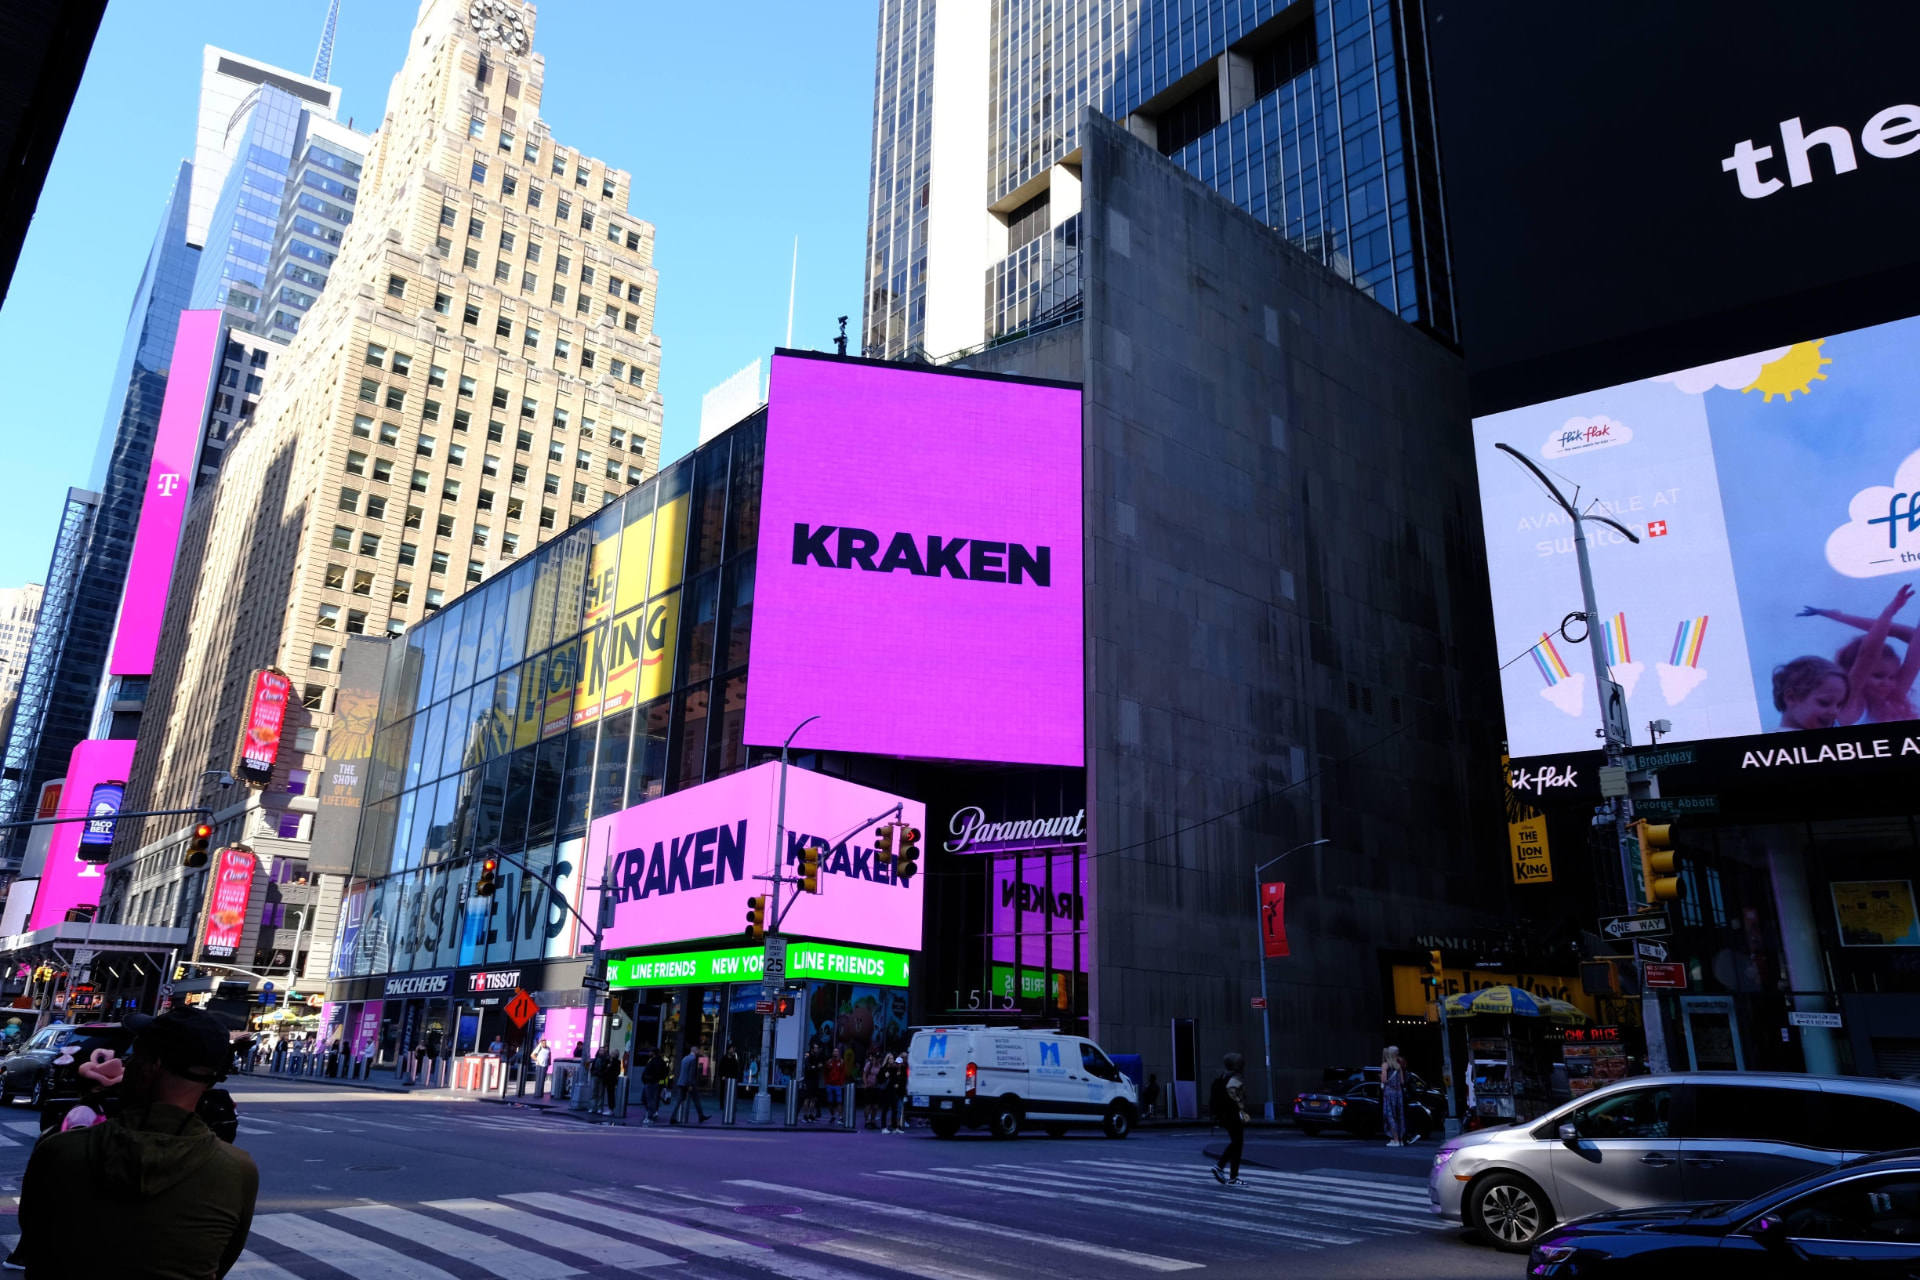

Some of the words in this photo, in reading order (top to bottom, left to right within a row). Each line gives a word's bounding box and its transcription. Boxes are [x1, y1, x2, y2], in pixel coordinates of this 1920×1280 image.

[1721, 103, 1920, 200] the
[1517, 495, 1644, 533] AVAIABLE
[1652, 488, 1681, 508] AT
[792, 522, 1051, 587] KRAKEN
[588, 605, 668, 697] KING
[575, 711, 583, 721] ON
[604, 695, 624, 710] STREET
[1638, 750, 1693, 768] Broadway
[1741, 739, 1892, 769] AVAILABLE
[246, 759, 270, 768] OPENING
[339, 763, 356, 775] THE
[332, 774, 358, 786] SHOW
[334, 785, 346, 795] OF
[346, 787, 352, 796] A
[322, 794, 361, 808] LIFETIME
[1635, 800, 1673, 811] George
[1678, 797, 1715, 808] Abbott
[90, 820, 112, 828] TACO
[90, 826, 111, 834] BELL
[943, 805, 1085, 852] Paramount
[1518, 831, 1538, 841] THE
[607, 819, 748, 904] KRAKEN
[1517, 844, 1543, 861] LION
[1515, 862, 1548, 880] KING
[449, 860, 573, 950] NEWS
[1610, 922, 1631, 933] ONE
[1639, 919, 1660, 930] WAY
[208, 945, 233, 953] OPENING
[631, 963, 653, 979] LINE
[654, 960, 697, 978] FRIENDS
[711, 957, 740, 975] NEW
[742, 955, 764, 973] YOR
[766, 958, 783, 972] 25
[794, 951, 825, 970] LINE
[827, 954, 885, 977] FRIENDS
[385, 975, 449, 995] SKECHERS
[486, 972, 520, 990] TISSOT
[1565, 1029, 1585, 1040] CHK
